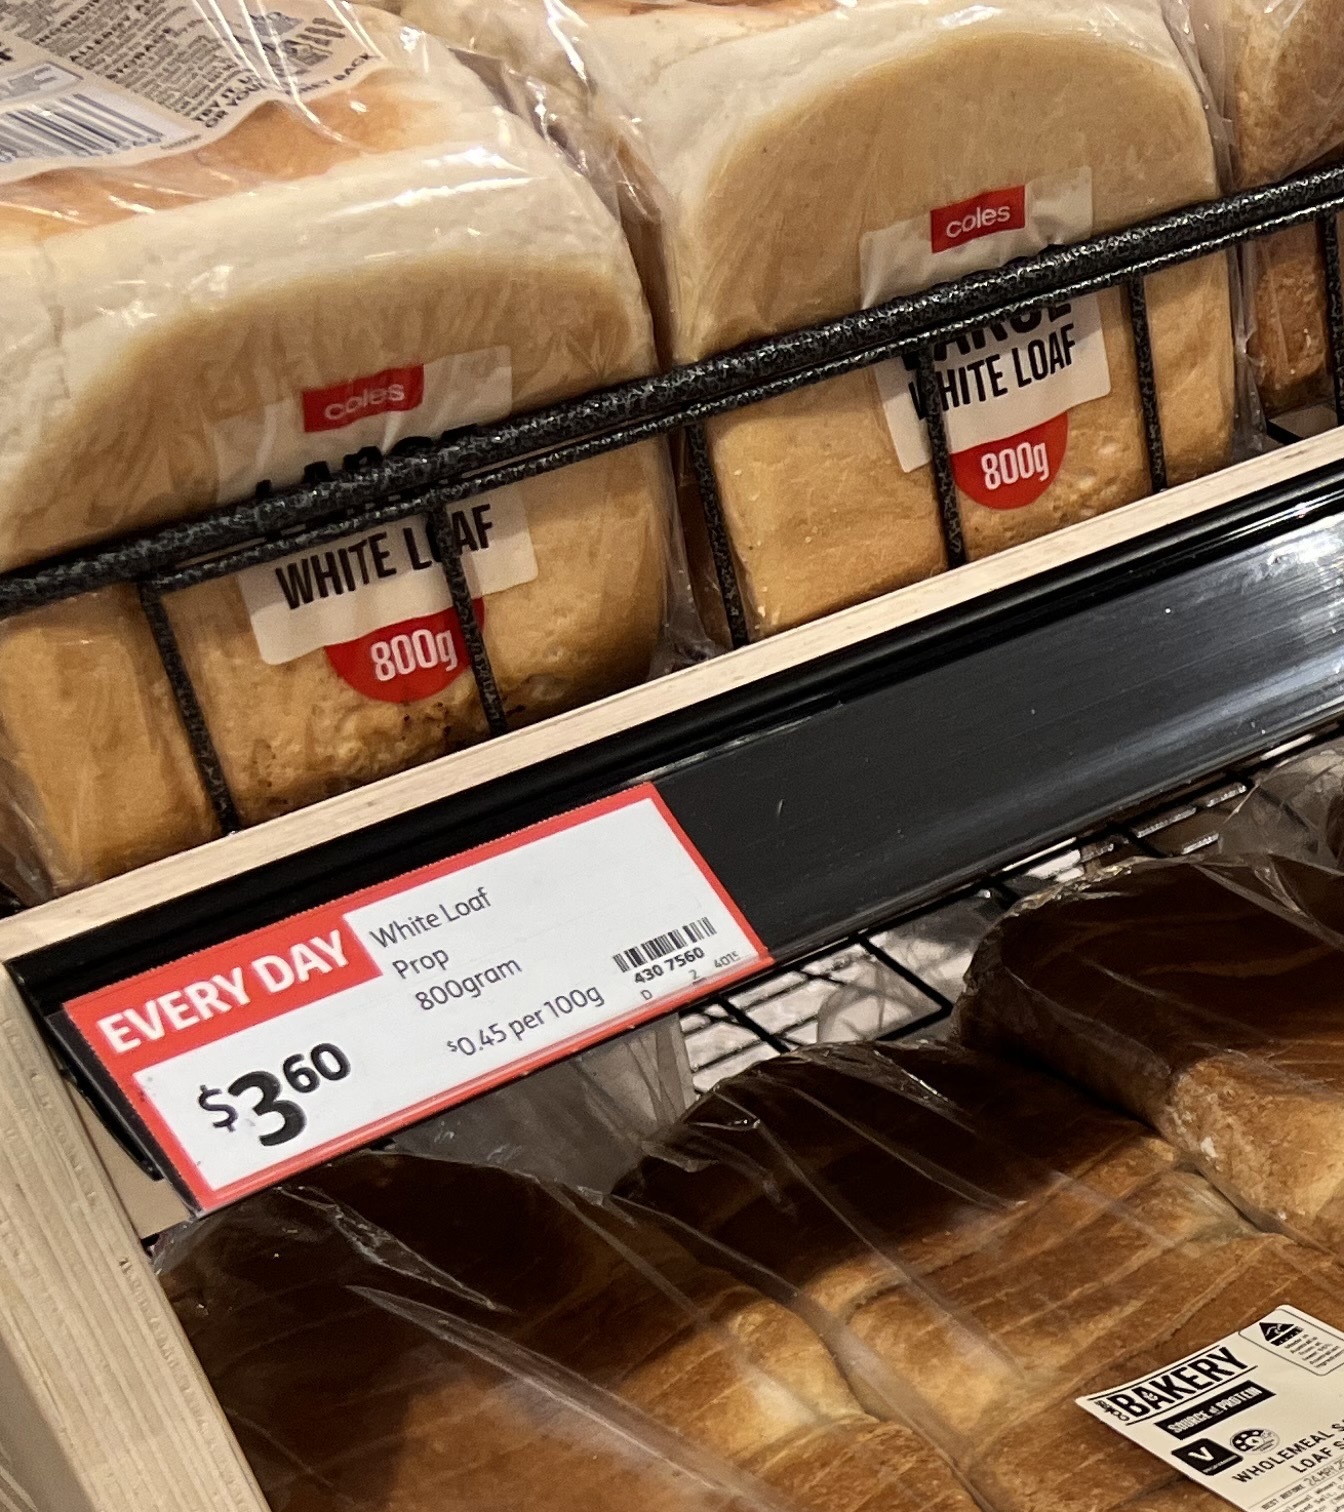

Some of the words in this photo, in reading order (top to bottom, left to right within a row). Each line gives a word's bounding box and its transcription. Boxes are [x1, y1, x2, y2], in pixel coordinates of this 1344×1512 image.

[946, 203, 1011, 238] coles
[1013, 323, 1076, 388] LOAF
[324, 384, 405, 420] coles
[981, 441, 1050, 490] 800g
[276, 532, 397, 610] WHITE
[370, 628, 458, 682] 800g
[371, 907, 442, 951] White
[445, 886, 492, 923] Loaf
[394, 946, 449, 981] Prop
[416, 957, 522, 1012] 800gram
[635, 962, 663, 986] 430
[665, 947, 704, 974] 7560
[97, 965, 251, 1055] EVERY
[251, 930, 351, 995] DAY
[448, 1021, 508, 1059] $0.45
[509, 1007, 547, 1043] per
[545, 985, 604, 1021] 100g
[1106, 1347, 1251, 1418] BAKERY
[1232, 1422, 1334, 1484] WHOLEMEAL
[1291, 1445, 1334, 1473] LOAF
